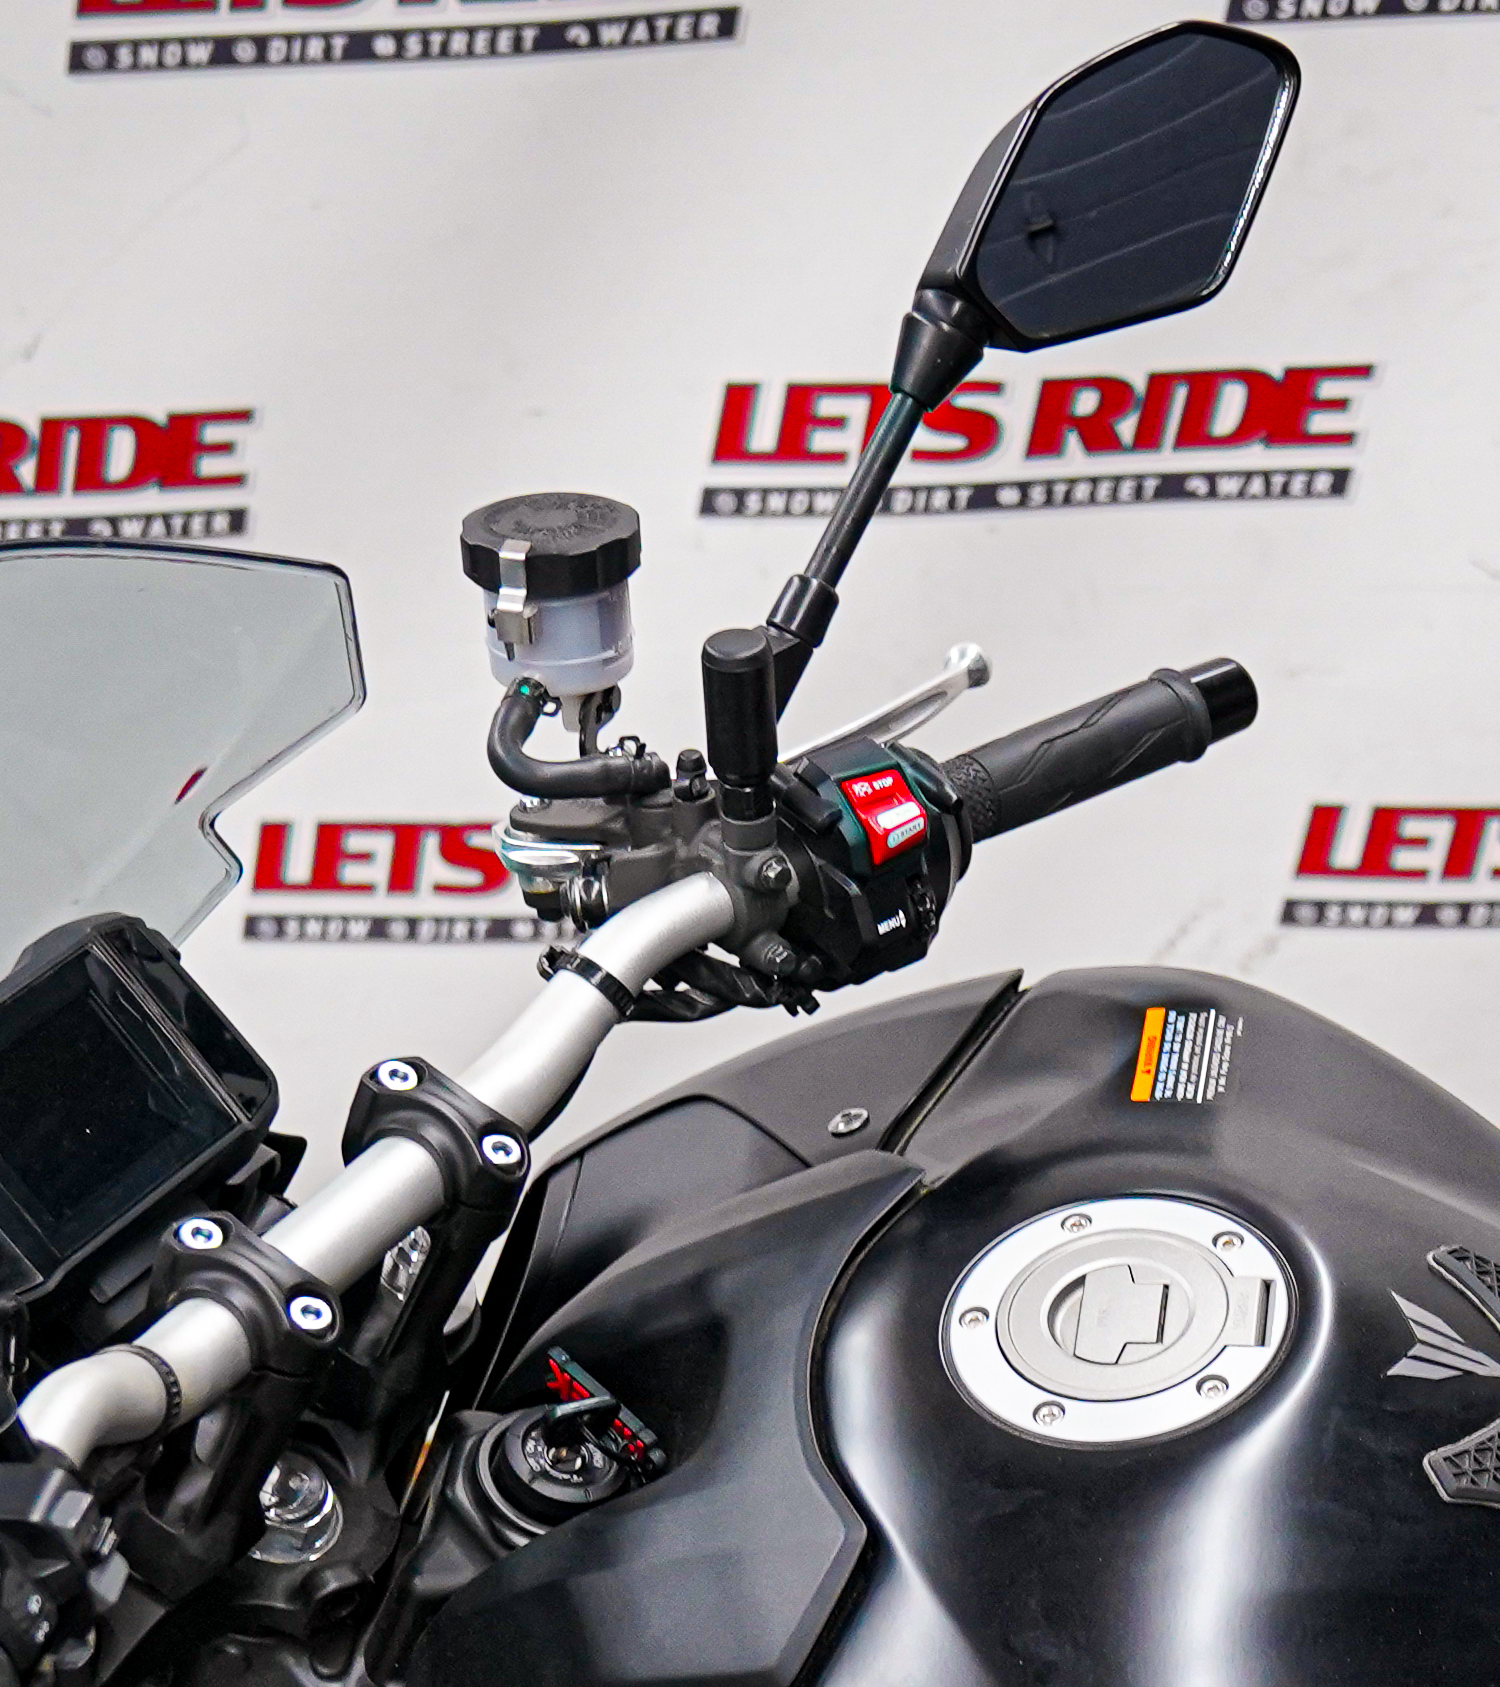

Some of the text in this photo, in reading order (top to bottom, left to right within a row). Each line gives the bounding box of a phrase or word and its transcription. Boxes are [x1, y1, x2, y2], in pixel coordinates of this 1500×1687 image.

[113, 13, 721, 68] SNOW DIRT STREET WATER
[1027, 365, 1373, 457] RIDE
[891, 485, 975, 512] DIRT
[1027, 477, 1163, 506] STREET
[1215, 471, 1334, 498] WATER
[117, 509, 230, 538] WATER
[251, 822, 512, 897] LETS
[282, 916, 489, 939] SNOW DIRT
[877, 915, 901, 936] MENU
[1323, 902, 1418, 925] SNOW
